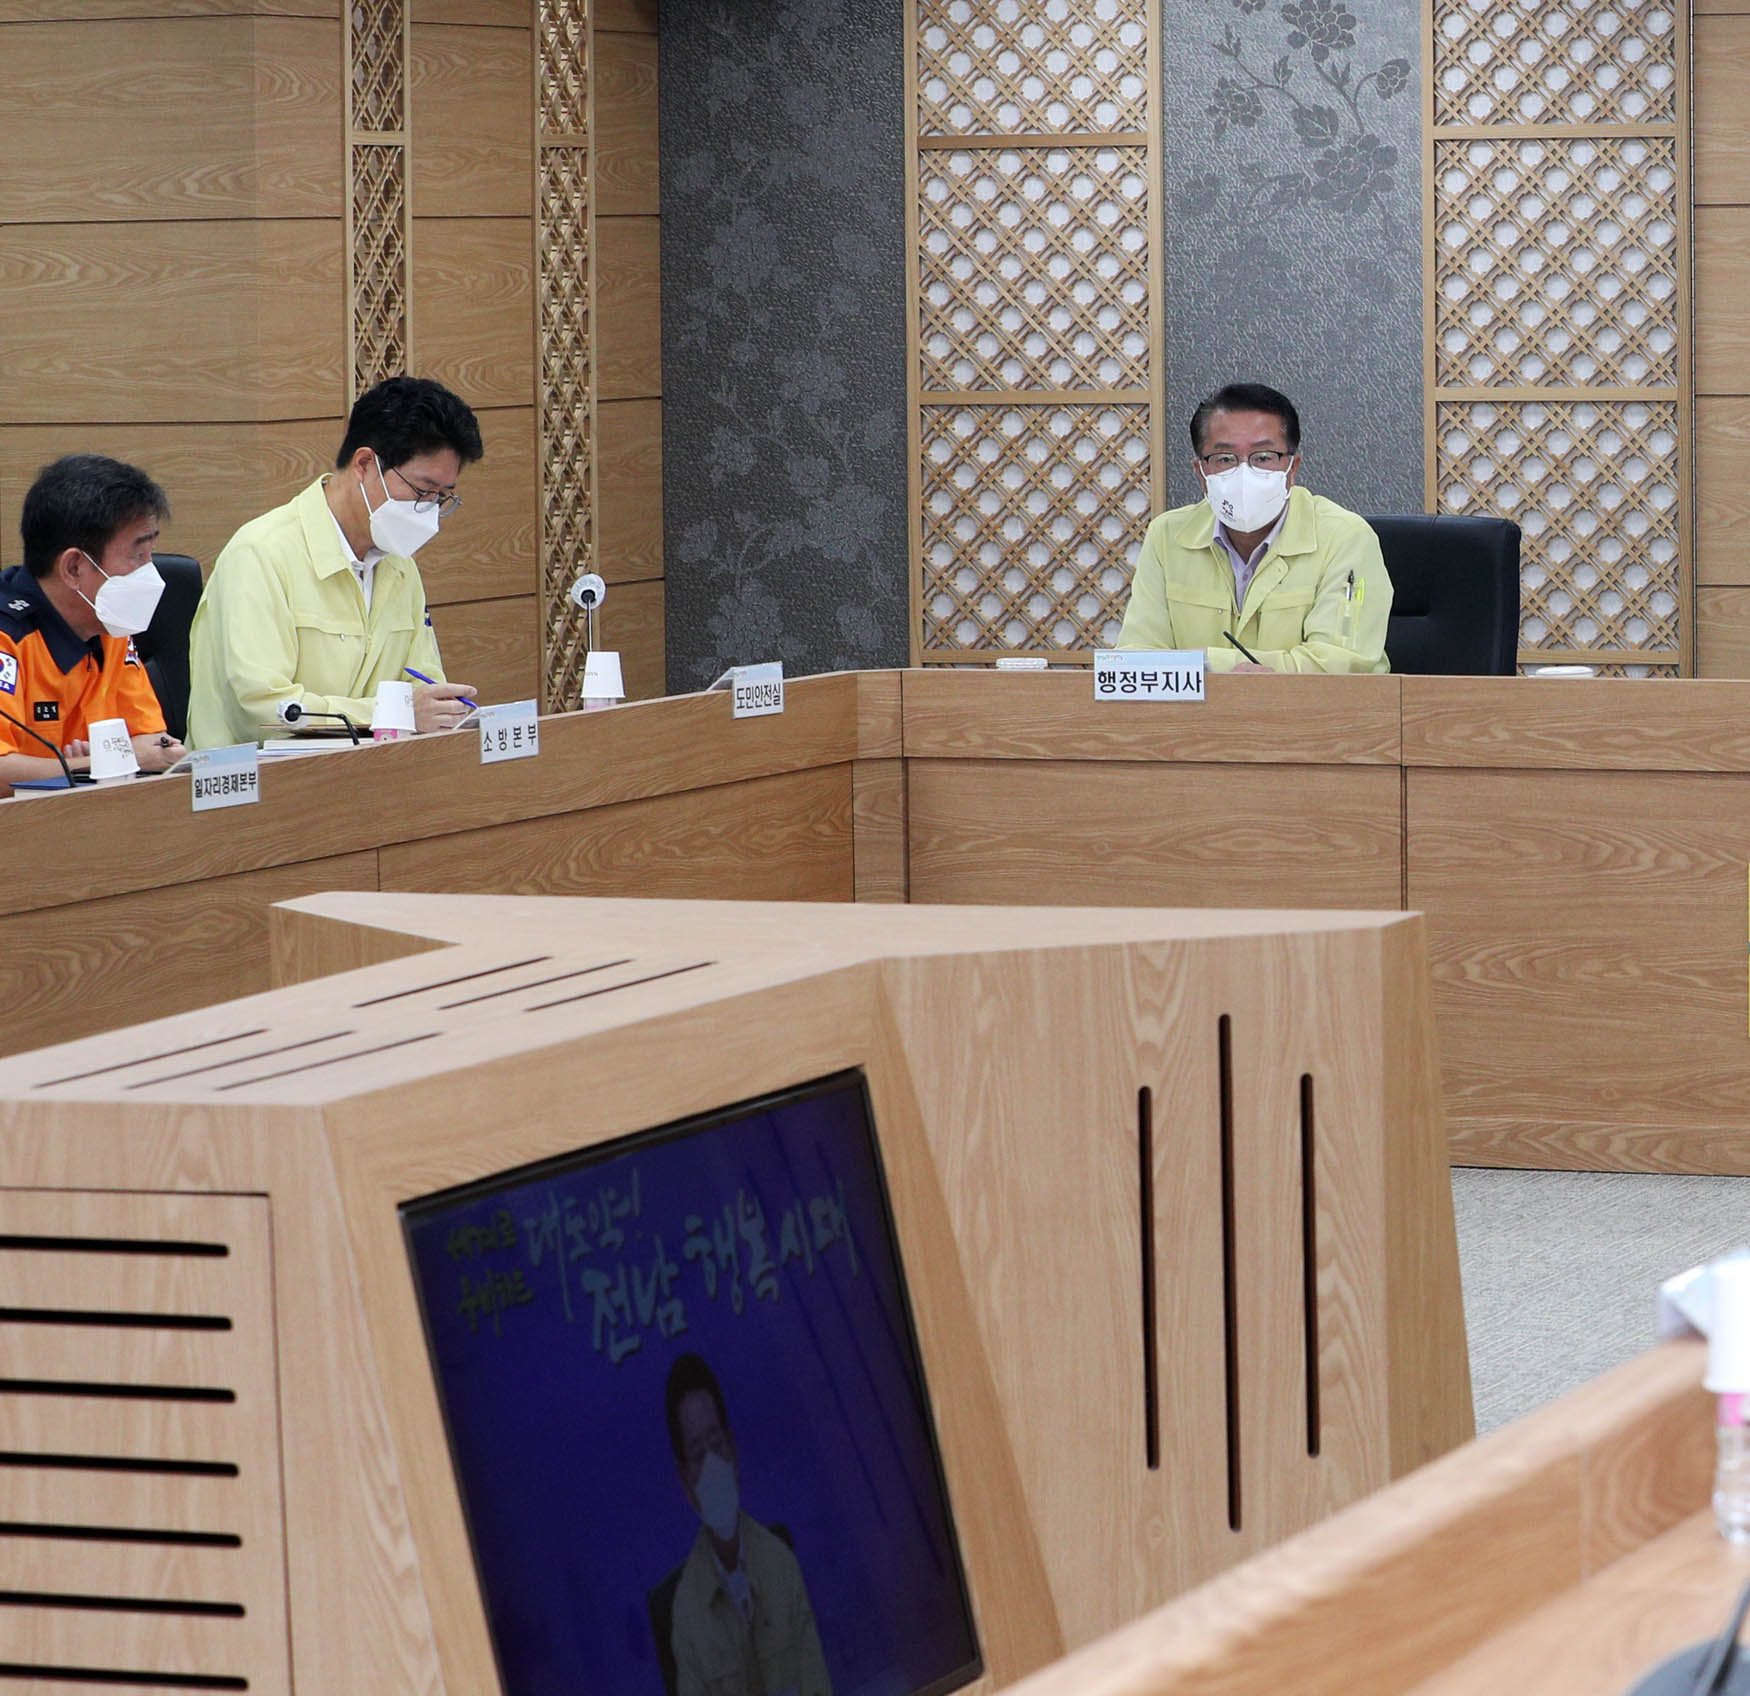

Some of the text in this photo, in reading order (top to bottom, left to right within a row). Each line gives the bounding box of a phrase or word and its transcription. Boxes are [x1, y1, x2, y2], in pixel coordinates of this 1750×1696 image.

[1097, 671, 1202, 693] 행정부지사
[736, 683, 781, 709] 도민안전실
[194, 771, 257, 798] 일자리경제본부
